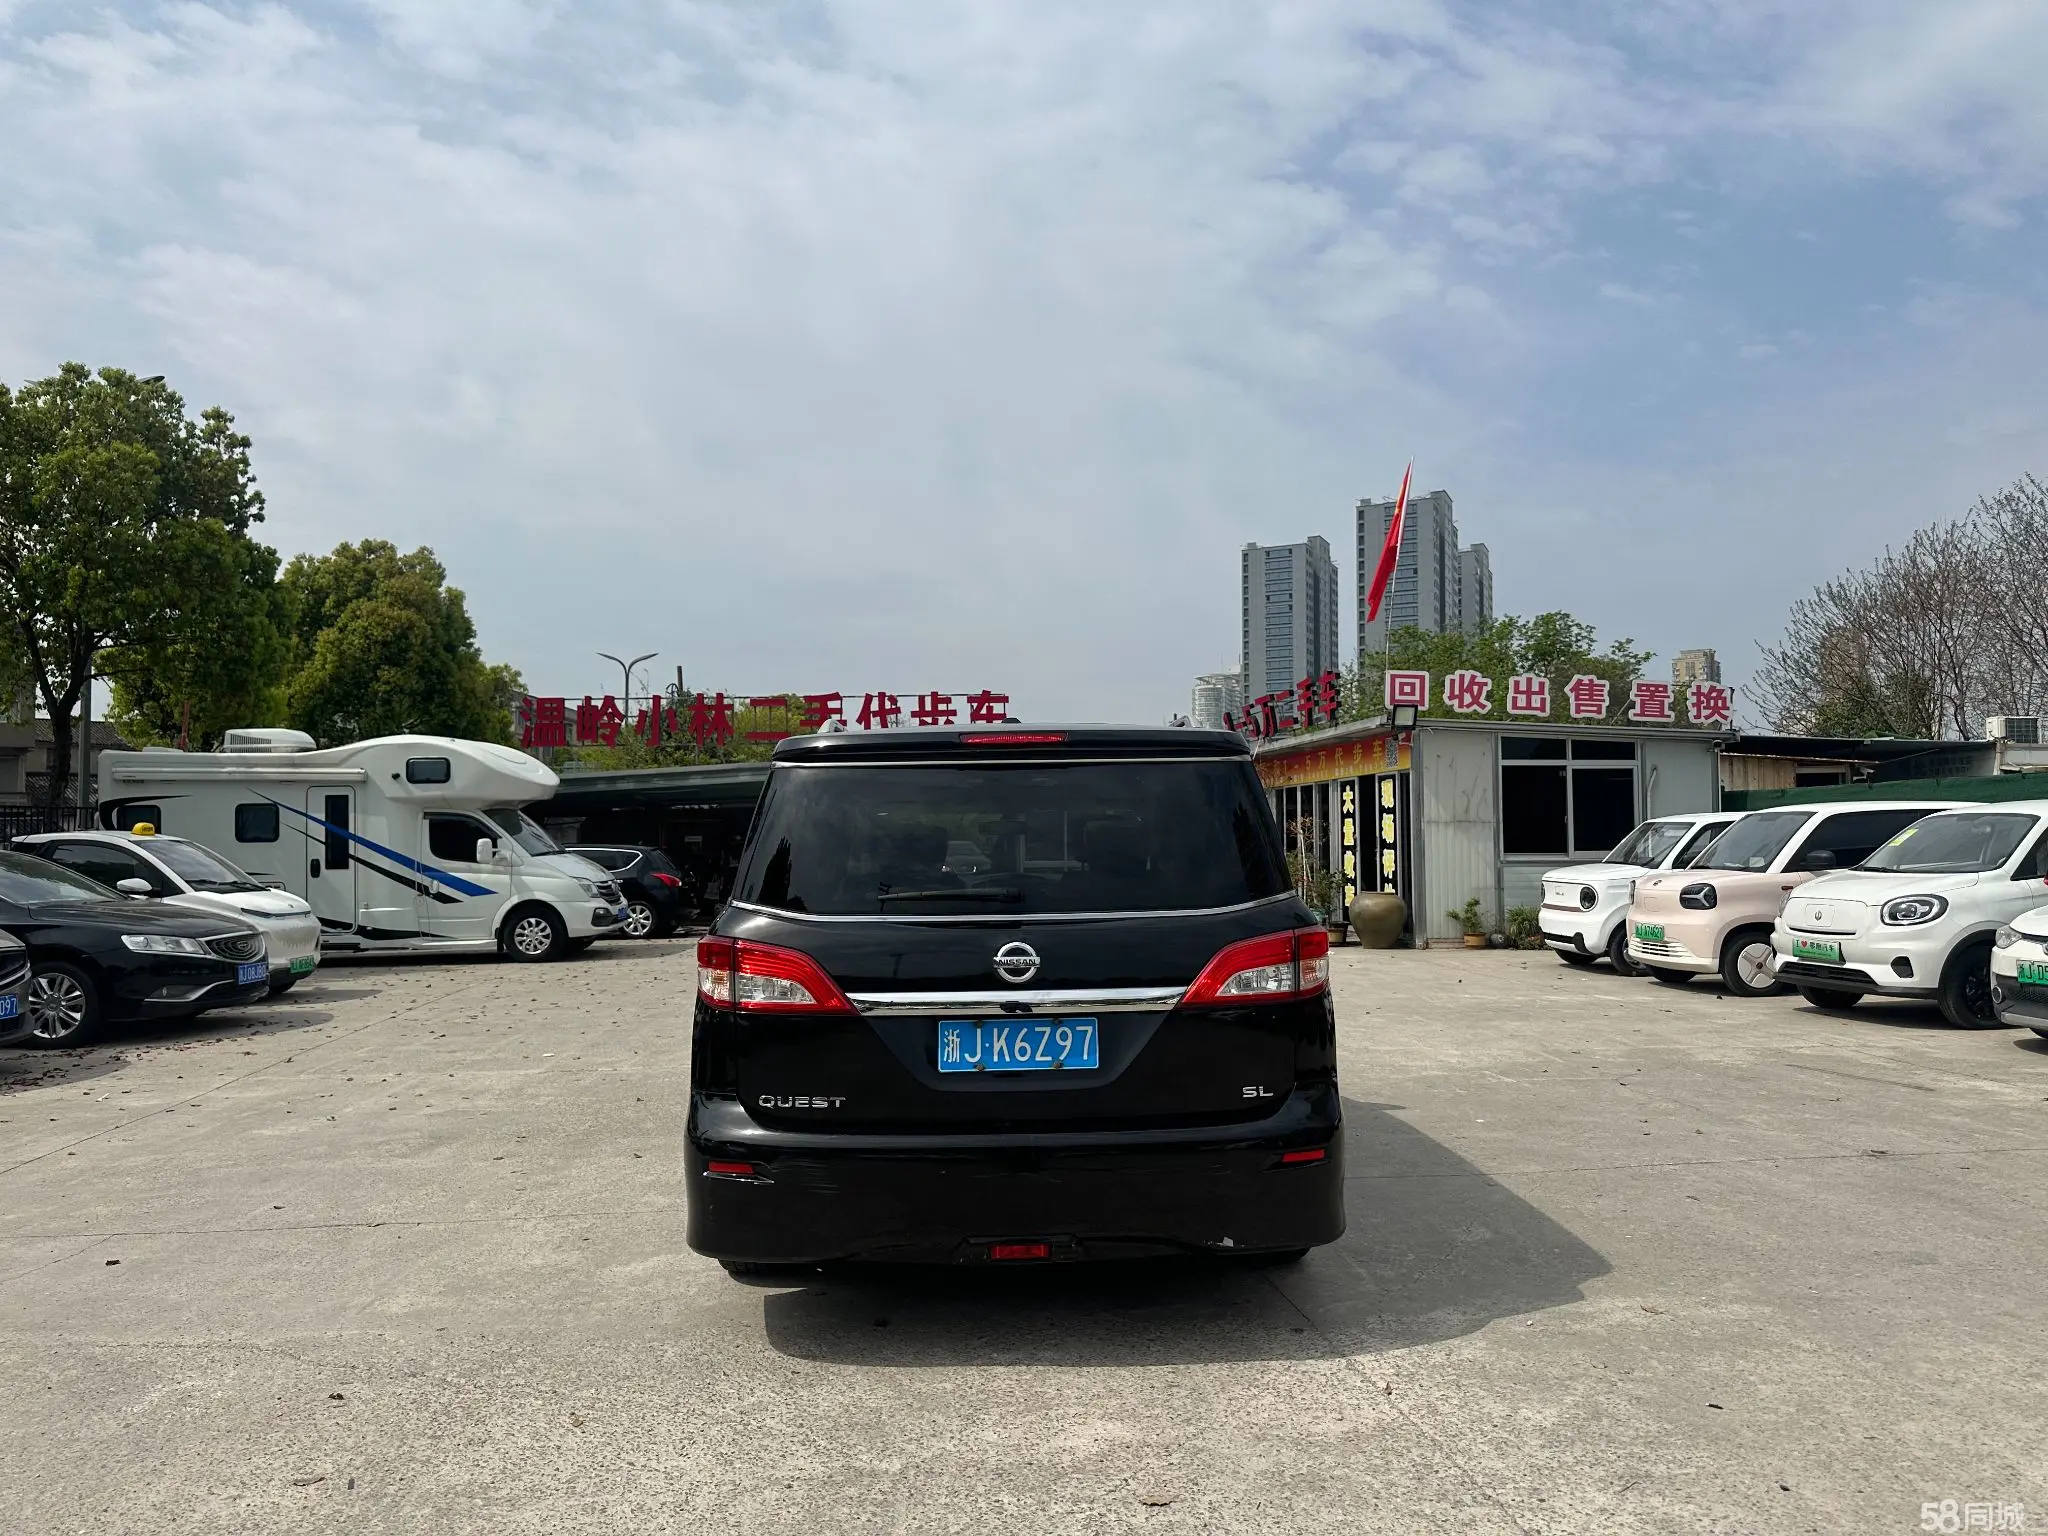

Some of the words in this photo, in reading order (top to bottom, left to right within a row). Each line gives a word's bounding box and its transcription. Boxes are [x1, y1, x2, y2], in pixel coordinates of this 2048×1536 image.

[1389, 672, 1732, 722] 回收出售置换
[520, 689, 1009, 748] 温岭小林二手代步车
[998, 958, 1037, 967] NISSAN
[1242, 1085, 1274, 1098] SL
[758, 1094, 847, 1109] QUEST
